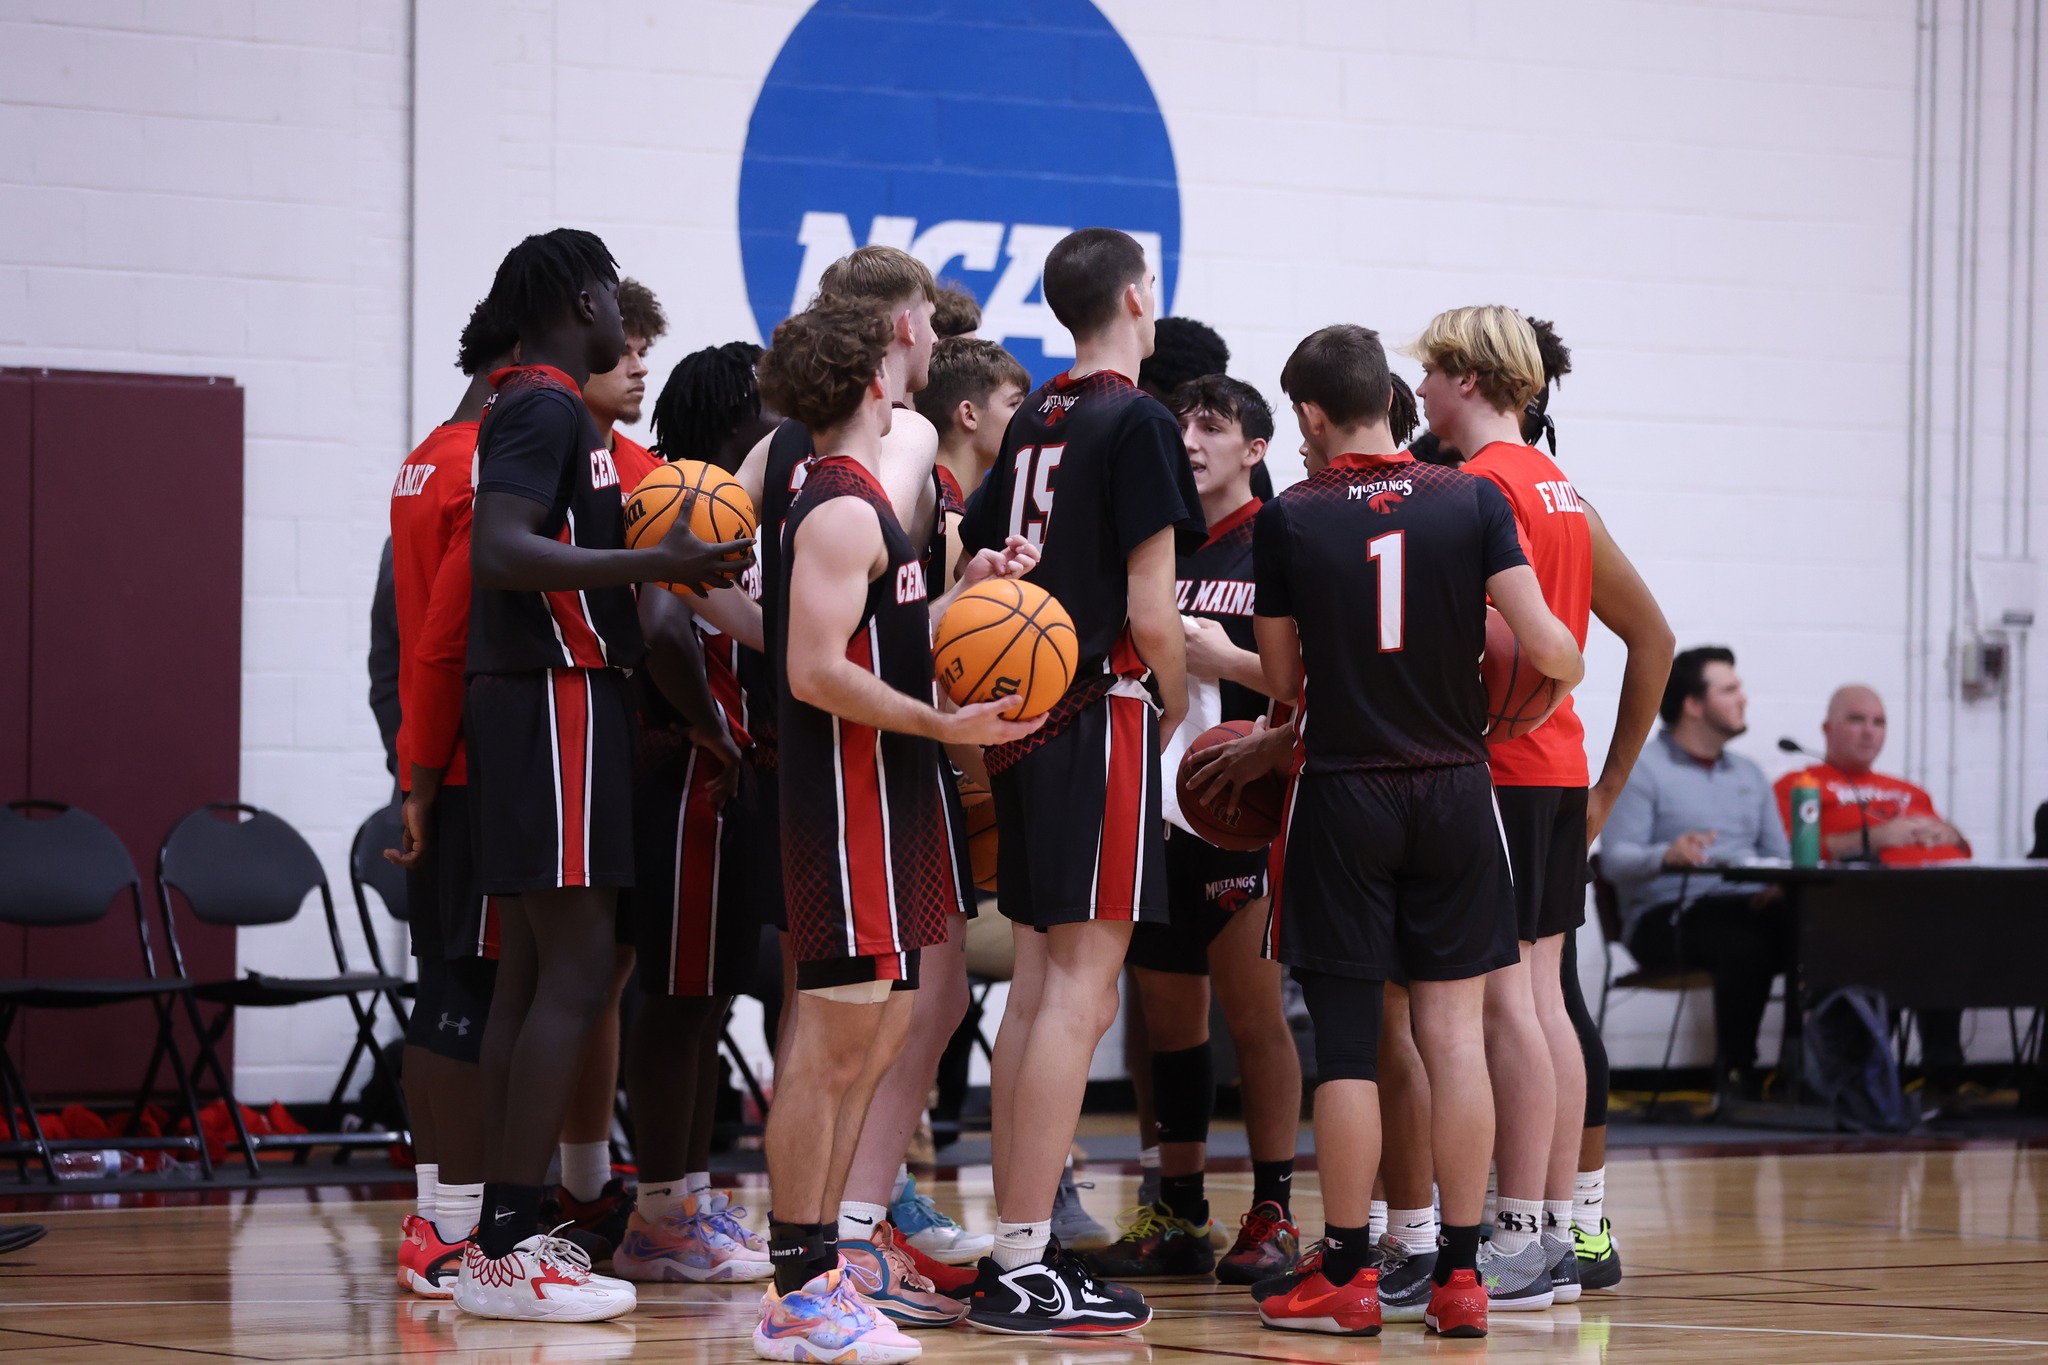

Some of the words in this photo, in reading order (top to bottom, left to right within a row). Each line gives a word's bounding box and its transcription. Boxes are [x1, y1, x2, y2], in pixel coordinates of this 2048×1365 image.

[788, 211, 1164, 358] NCA
[392, 464, 437, 499] AMILY
[1347, 479, 1413, 501] MUSTANGS
[1009, 442, 1068, 566] 15
[1189, 580, 1256, 616] MAINE
[1366, 529, 1406, 653] 1
[1205, 875, 1257, 901] MUSTANGS
